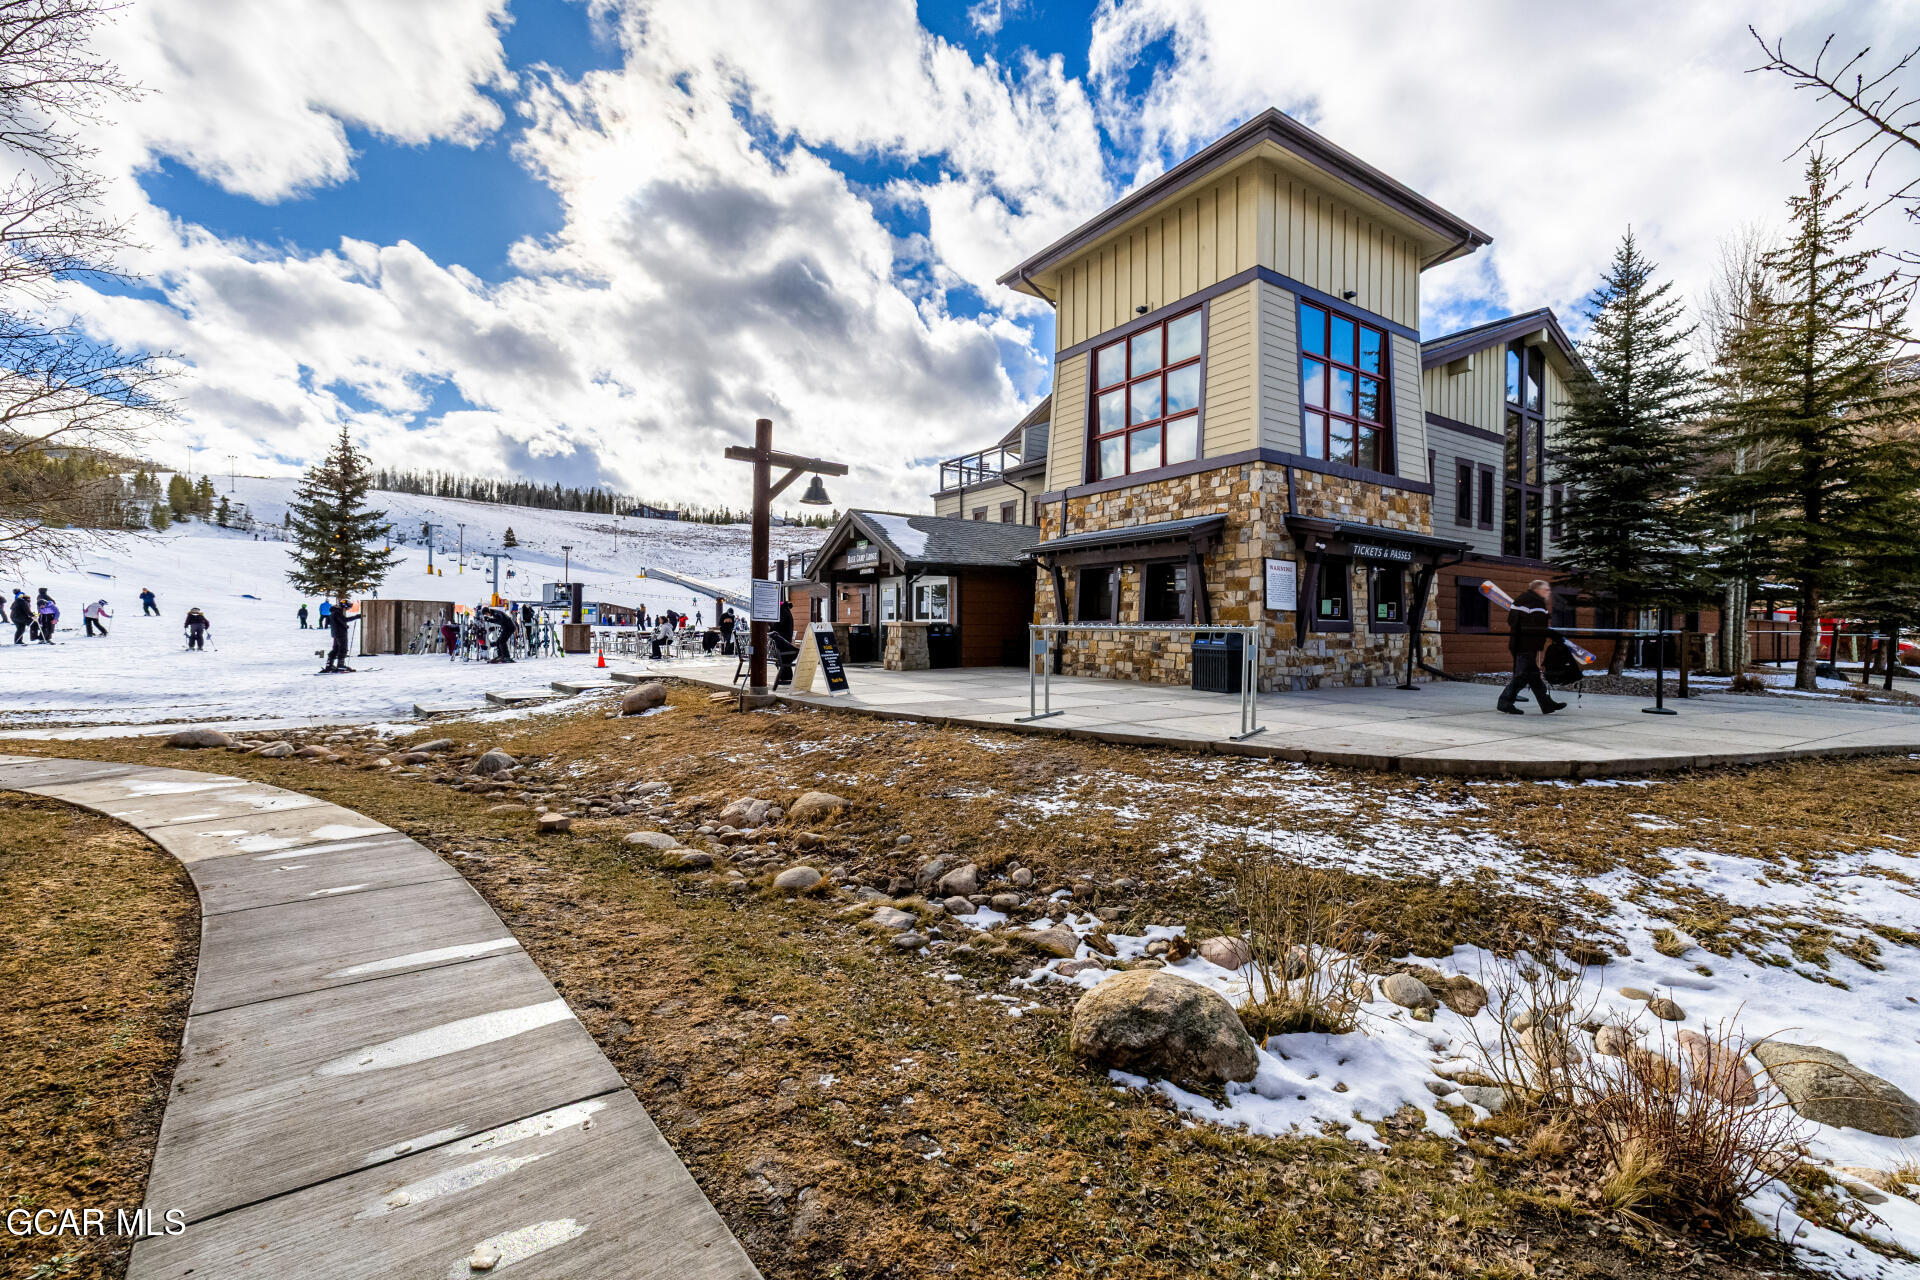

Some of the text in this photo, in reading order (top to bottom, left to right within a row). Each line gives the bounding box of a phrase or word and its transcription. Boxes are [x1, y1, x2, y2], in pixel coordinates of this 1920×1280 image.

[1353, 545, 1412, 560] TICKETS & PASSES
